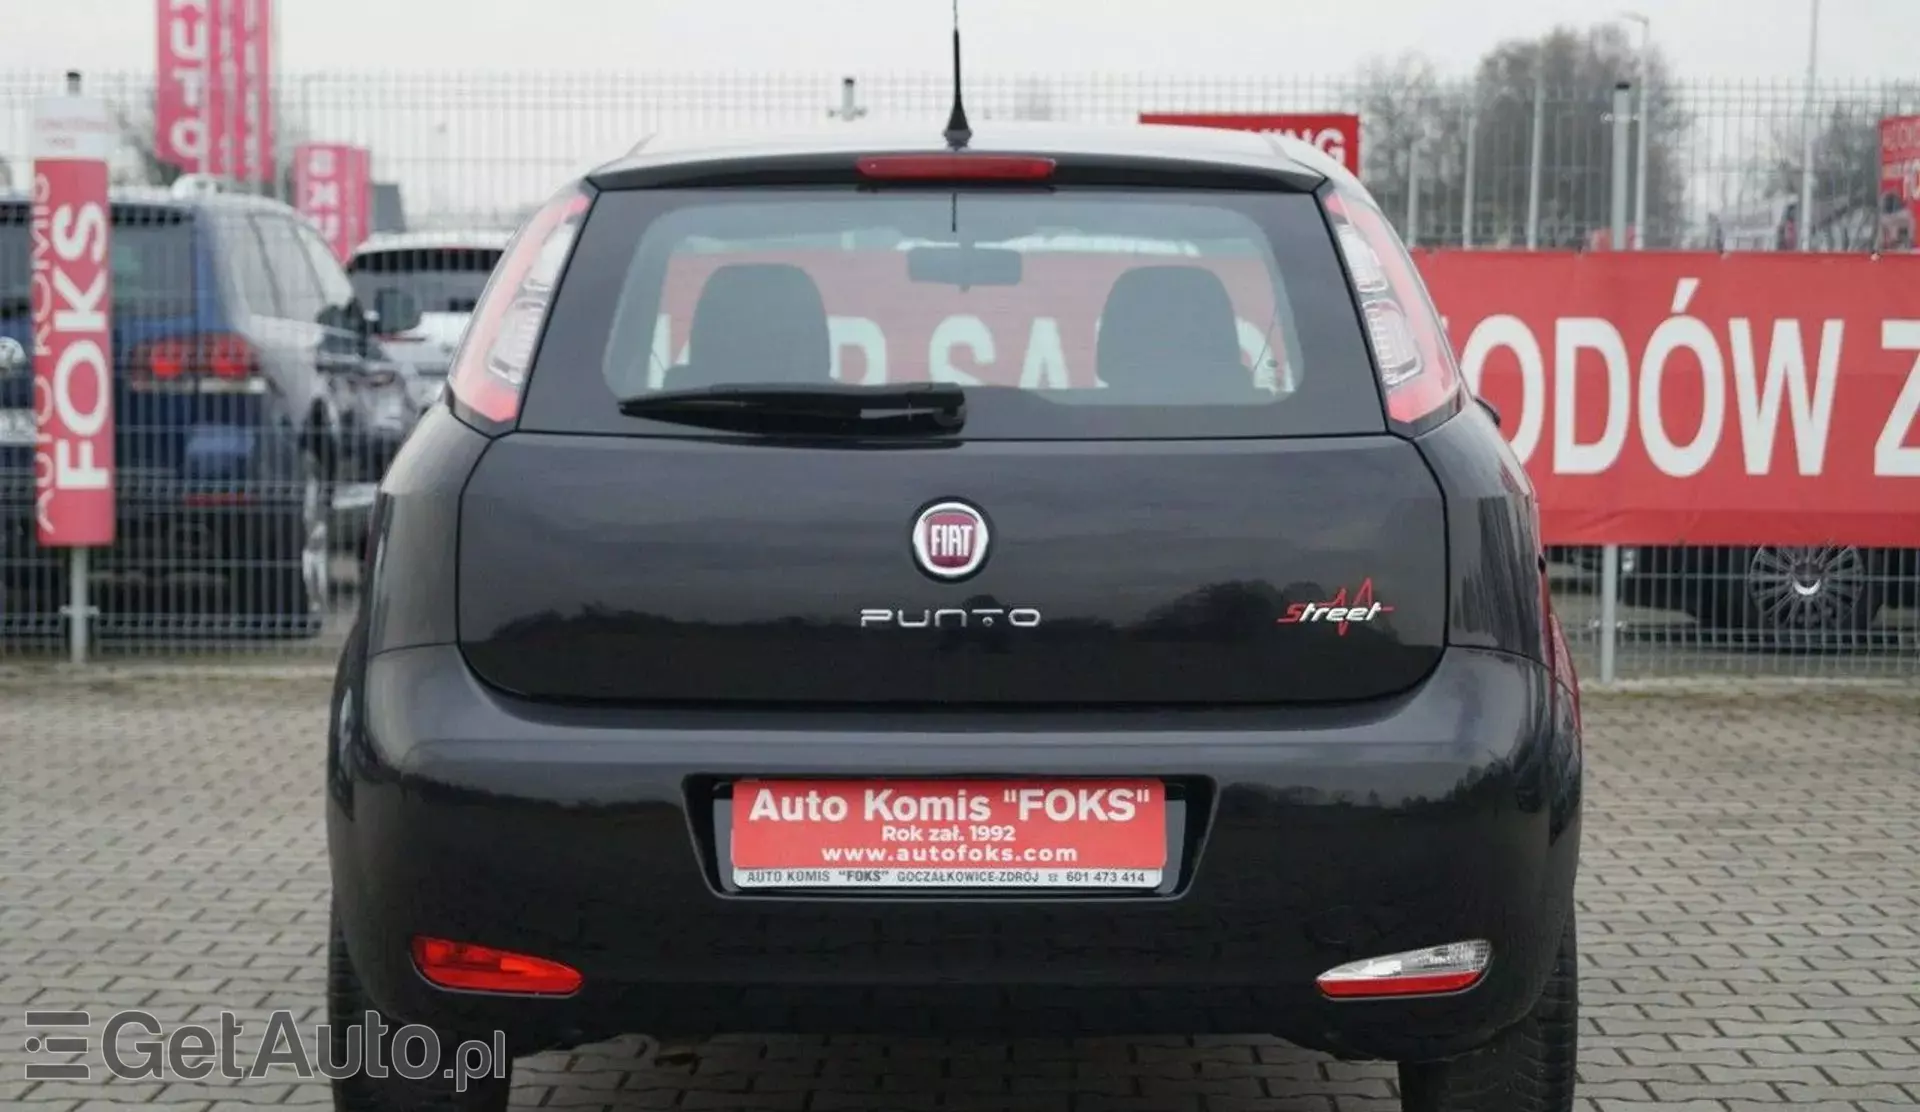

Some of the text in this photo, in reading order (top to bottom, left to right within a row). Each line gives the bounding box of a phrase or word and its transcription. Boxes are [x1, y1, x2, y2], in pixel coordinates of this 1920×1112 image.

[170, 0, 209, 158] UTO
[53, 202, 109, 490] FOKS
[931, 523, 973, 557] FIAT
[860, 608, 1041, 628] PUNTO
[749, 788, 1150, 822] Auto Komis "FOKS"
[882, 823, 1016, 842] Rok zał. 1992
[821, 844, 1078, 862] www.autofoks.com
[747, 871, 782, 883] AUTO
[787, 871, 830, 883] KOMIS
[1066, 871, 1089, 883] 601
[1093, 871, 1118, 883] 473
[1121, 871, 1146, 883] 414
